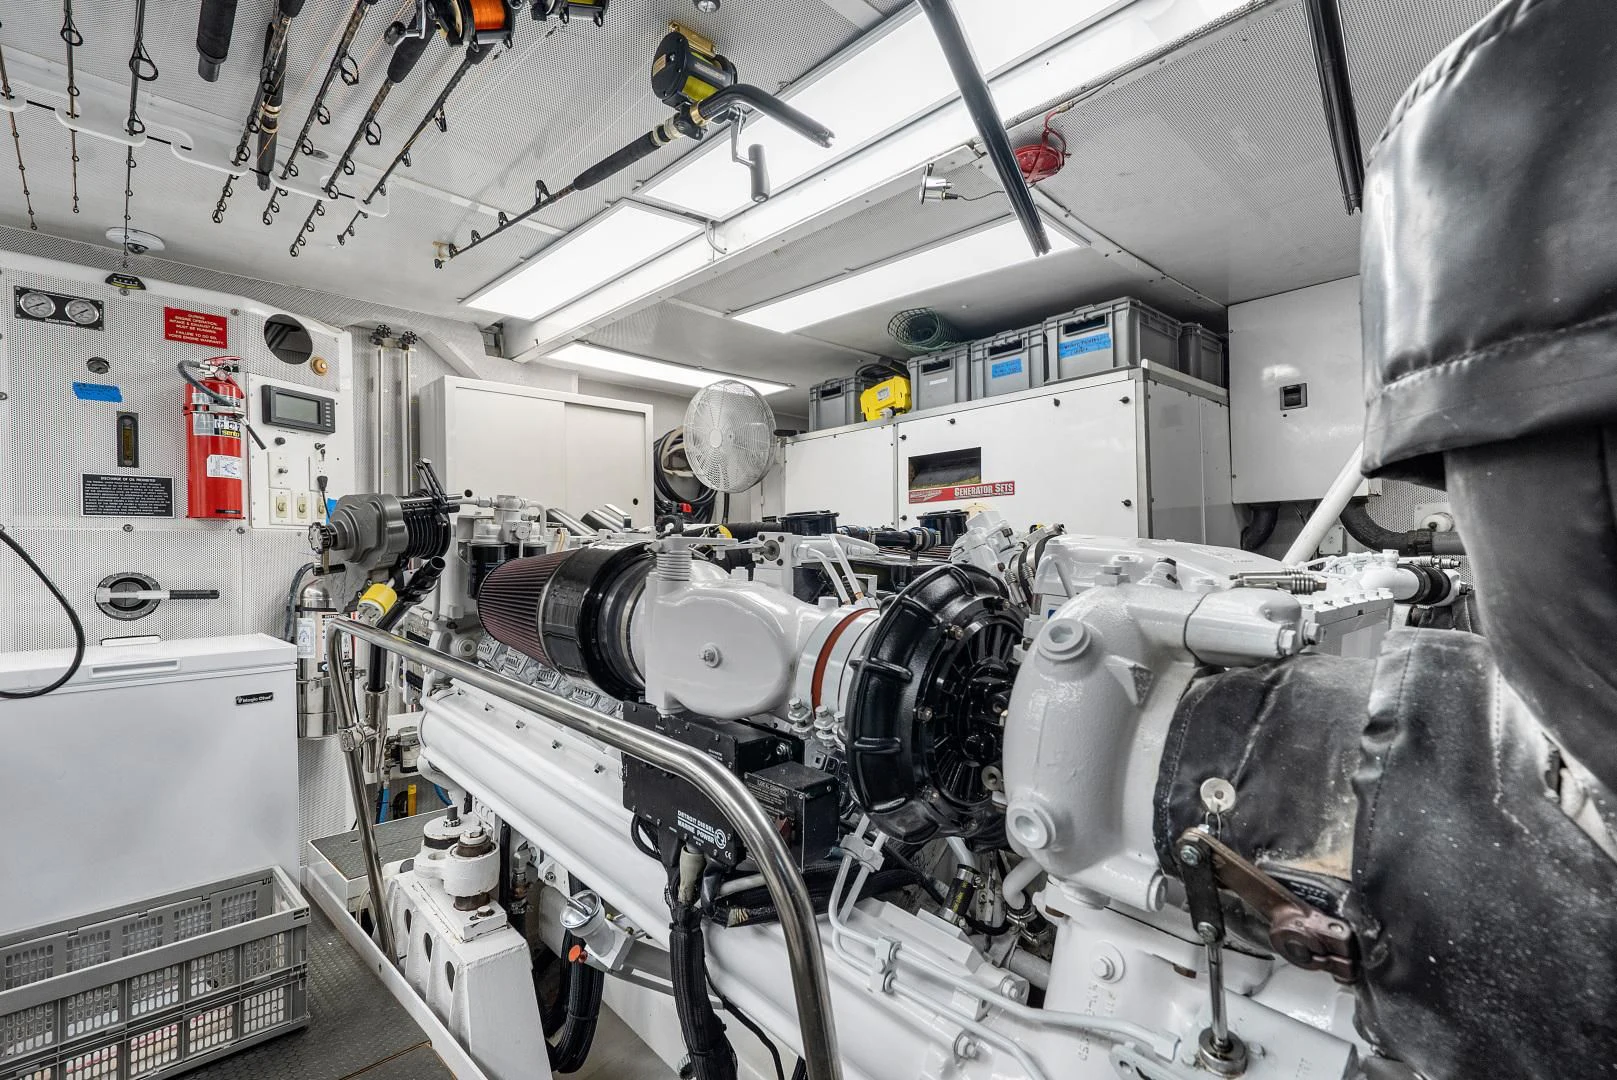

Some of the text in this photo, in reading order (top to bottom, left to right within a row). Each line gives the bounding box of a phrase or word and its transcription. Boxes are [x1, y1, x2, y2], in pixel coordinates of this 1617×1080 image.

[677, 809, 715, 835] DETROIT DIESEL
[677, 819, 696, 835] MARINE
[696, 829, 715, 845] POWER
